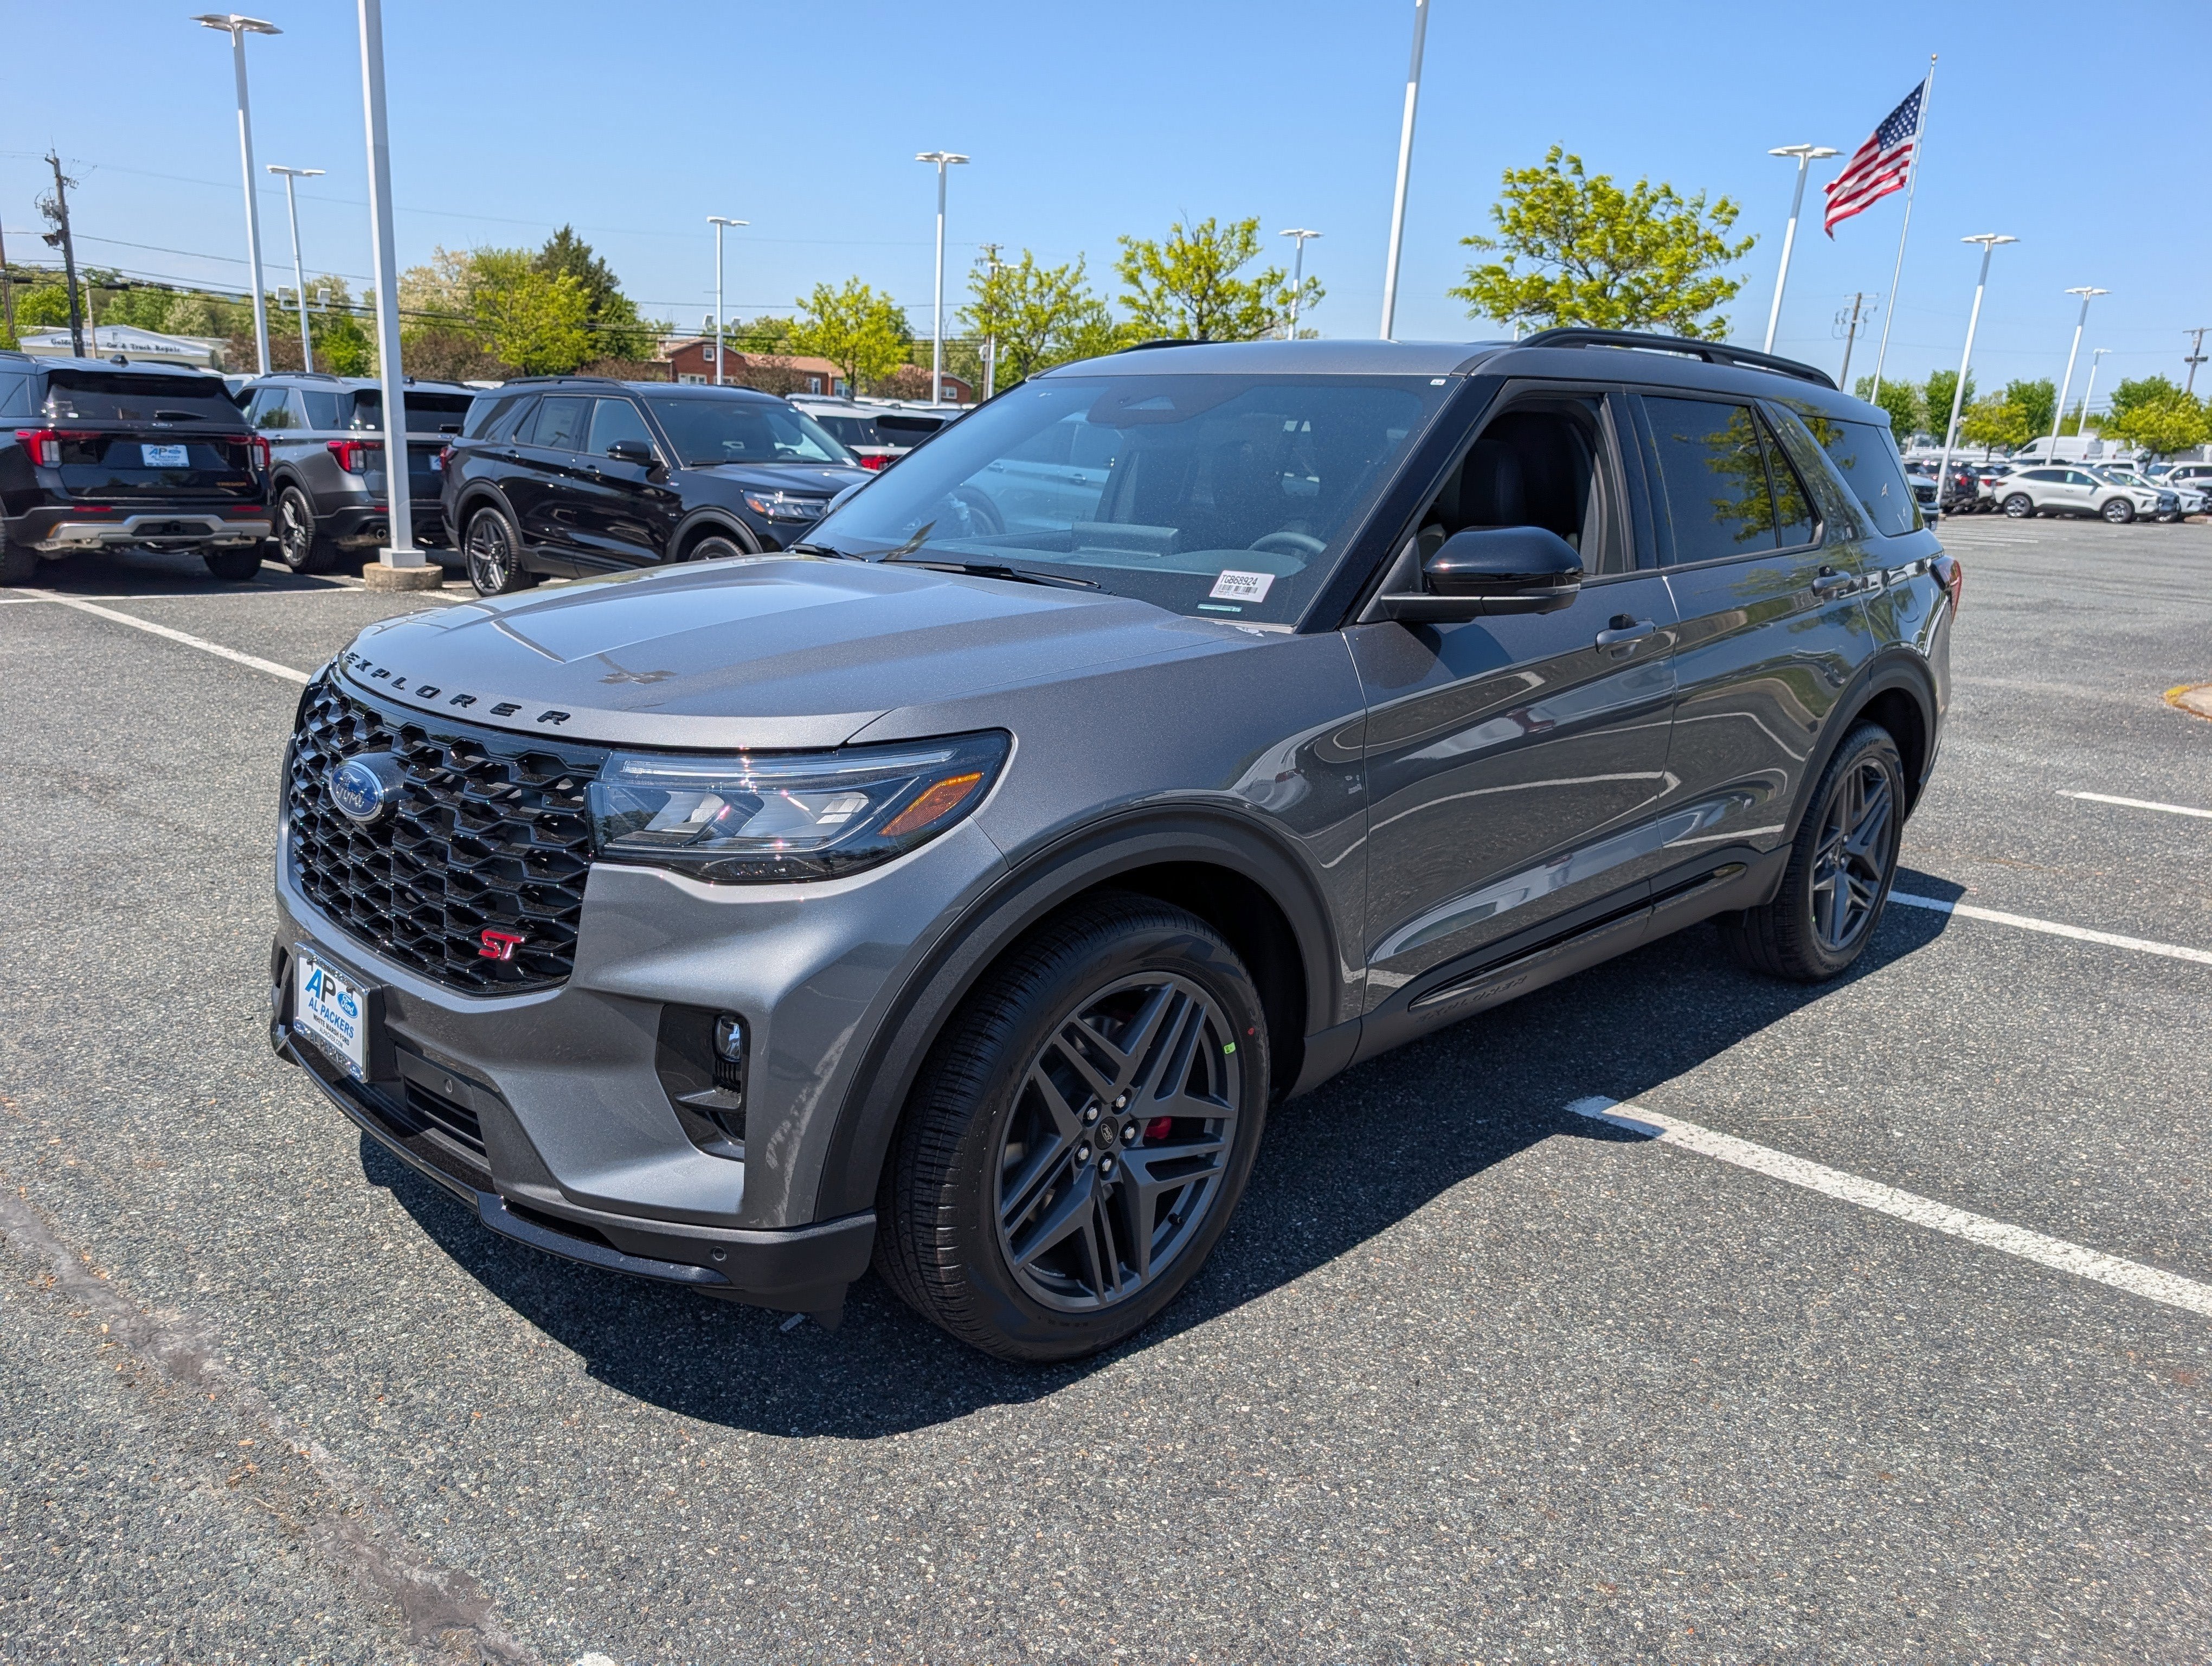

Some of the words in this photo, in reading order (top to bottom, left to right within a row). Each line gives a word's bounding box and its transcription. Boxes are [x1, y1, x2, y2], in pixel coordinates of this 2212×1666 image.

[344, 652, 571, 726] EXPLORER
[478, 929, 525, 960] ST
[305, 968, 336, 1003] AP
[308, 997, 318, 1013] AL
[320, 1004, 354, 1039] PACKERS
[340, 994, 356, 1016] Ford
[313, 1013, 325, 1028] WHITE
[326, 1022, 339, 1038] MARSH
[339, 1033, 350, 1046] FORD
[319, 1026, 344, 1049] ALPACKER.COM
